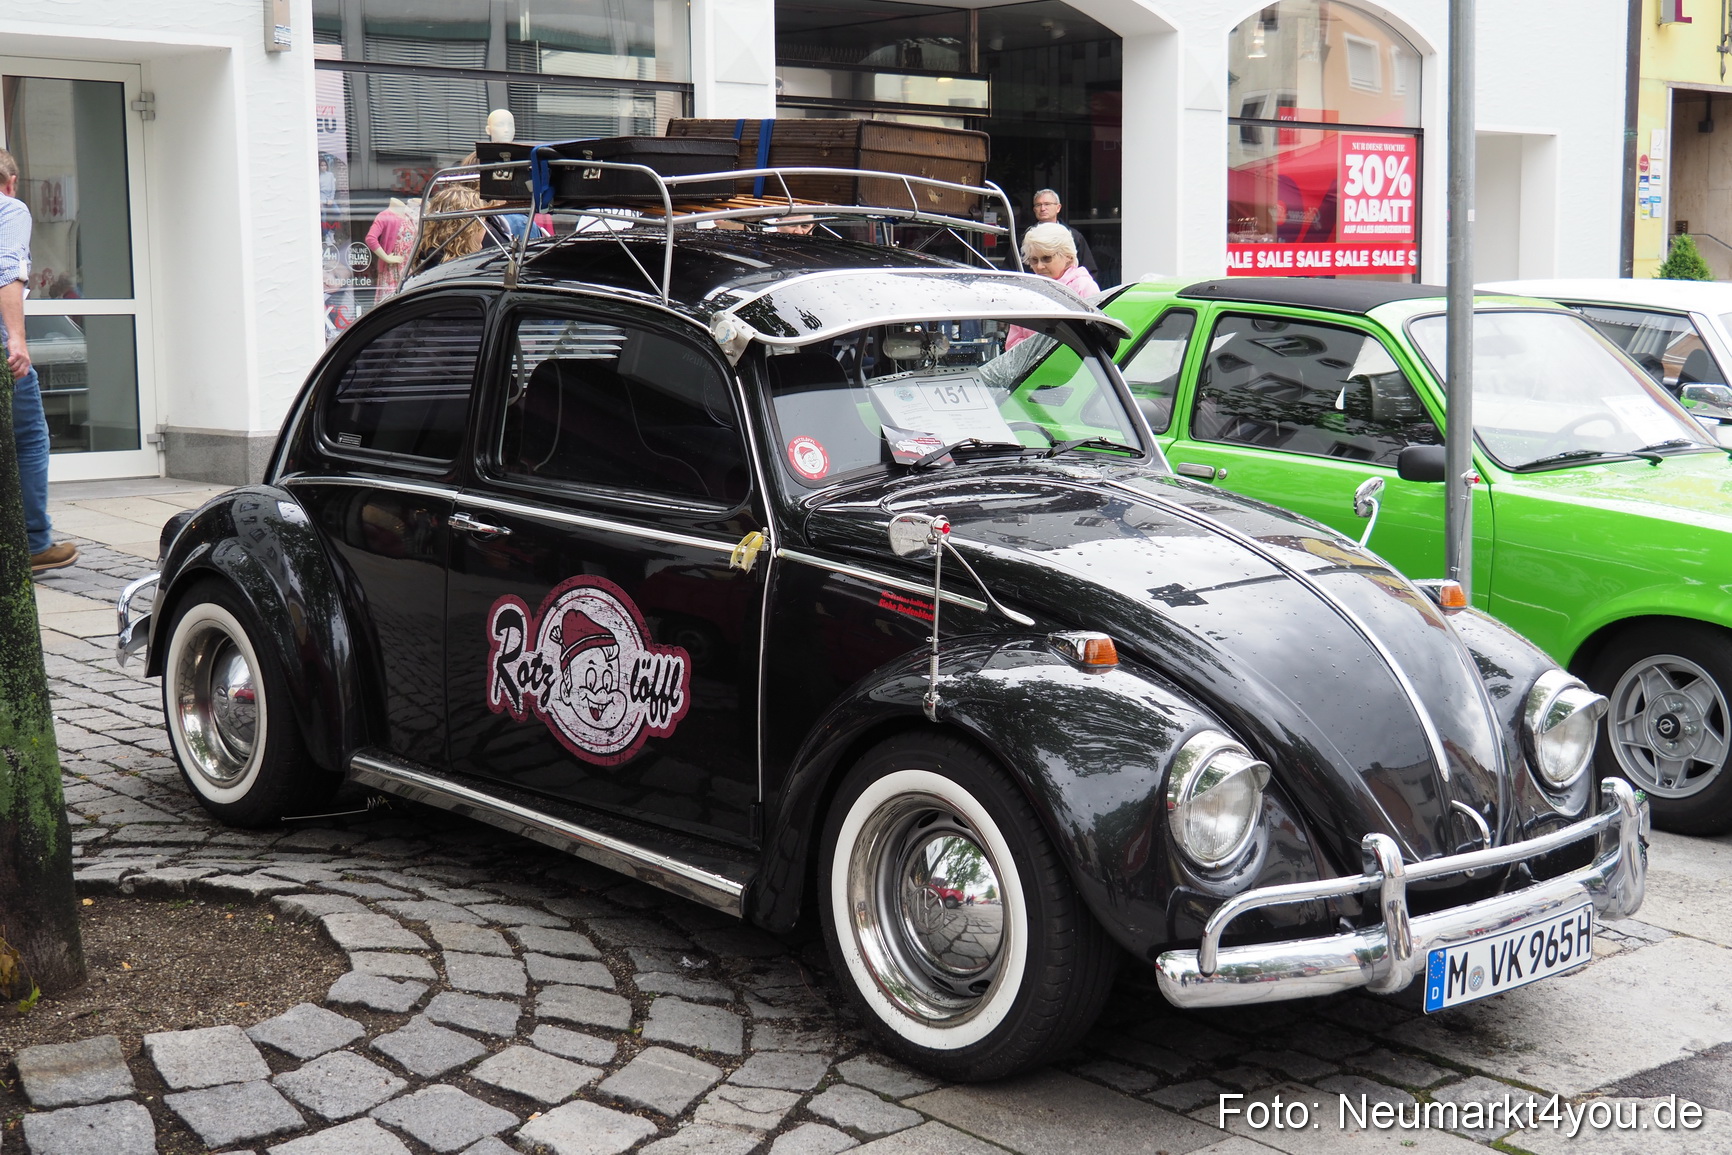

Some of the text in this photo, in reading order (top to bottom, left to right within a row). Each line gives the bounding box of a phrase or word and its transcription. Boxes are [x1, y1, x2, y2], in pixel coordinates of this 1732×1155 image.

[1384, 144, 1406, 152] WOCHE
[1344, 154, 1412, 197] 30%
[1344, 198, 1412, 222] RABATT
[1257, 250, 1293, 268] SALE
[1296, 250, 1331, 268] SALE
[1334, 250, 1369, 267] SALE
[1372, 249, 1404, 267] SALE
[934, 385, 970, 405] 151
[495, 608, 556, 712] Rotz
[1431, 986, 1440, 1000] D
